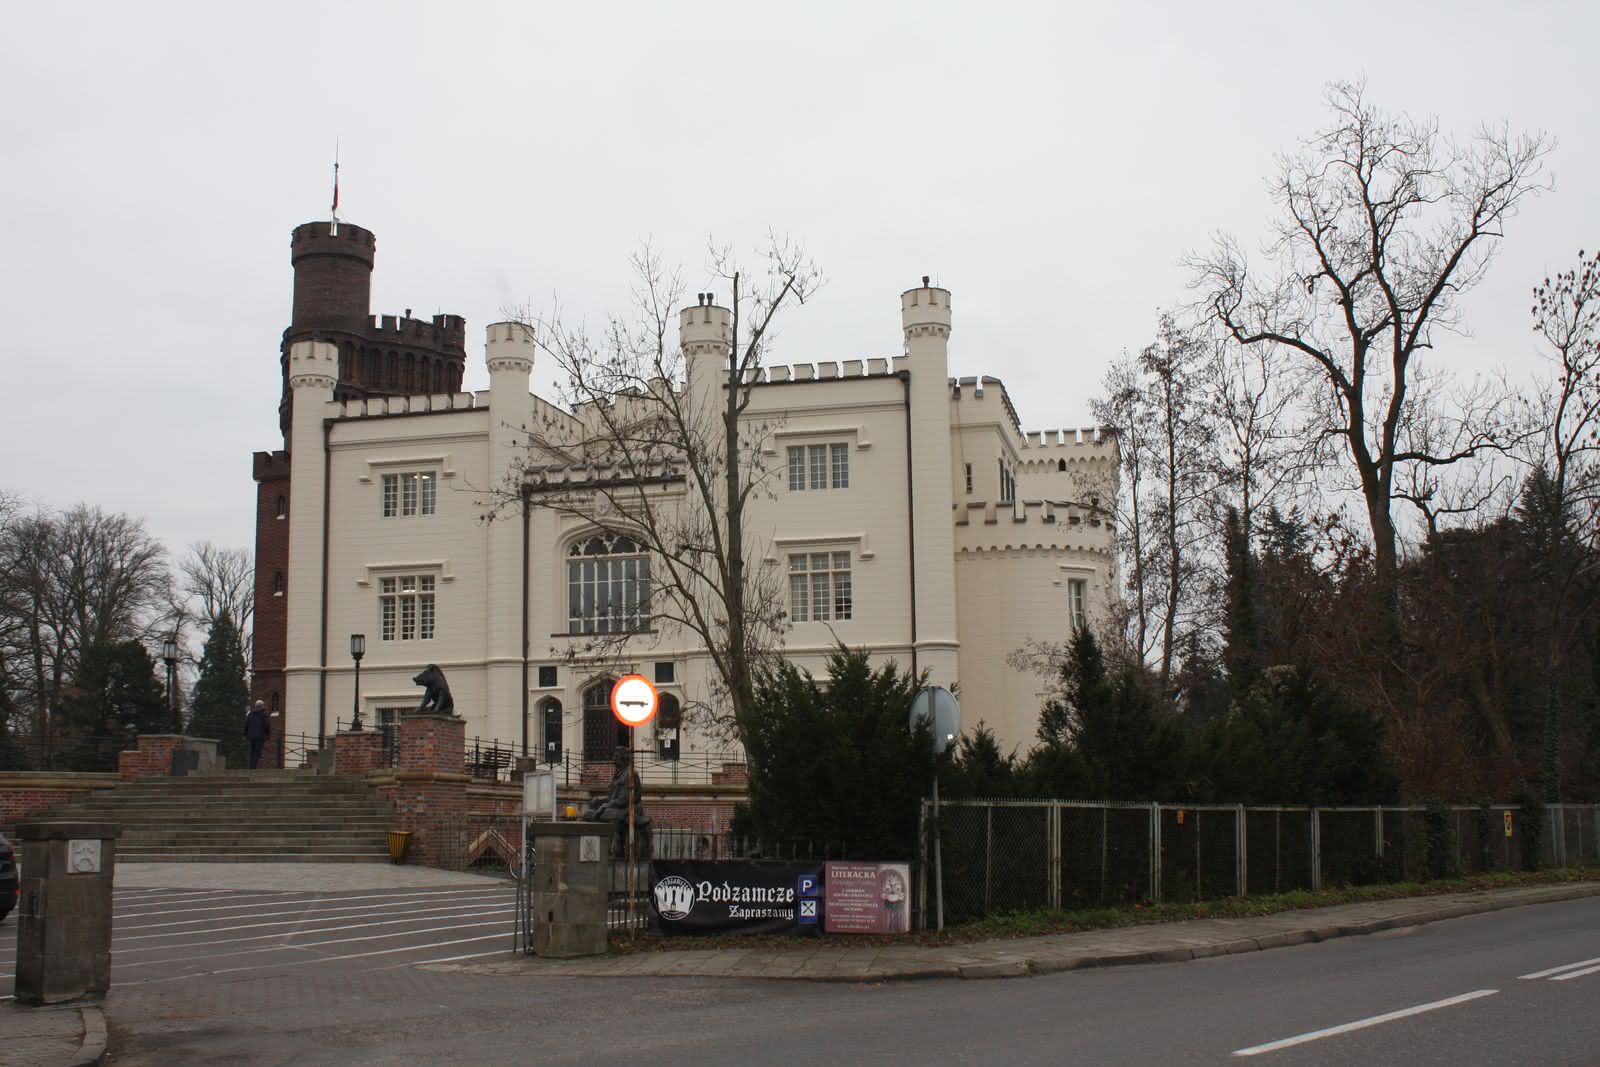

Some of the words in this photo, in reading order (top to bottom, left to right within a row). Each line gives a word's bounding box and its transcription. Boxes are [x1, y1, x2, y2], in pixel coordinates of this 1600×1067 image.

[831, 871, 876, 879] LITERACKA
[696, 880, 794, 902] Podzamcze
[802, 880, 812, 892] P
[729, 905, 794, 920] Zapraszamy
